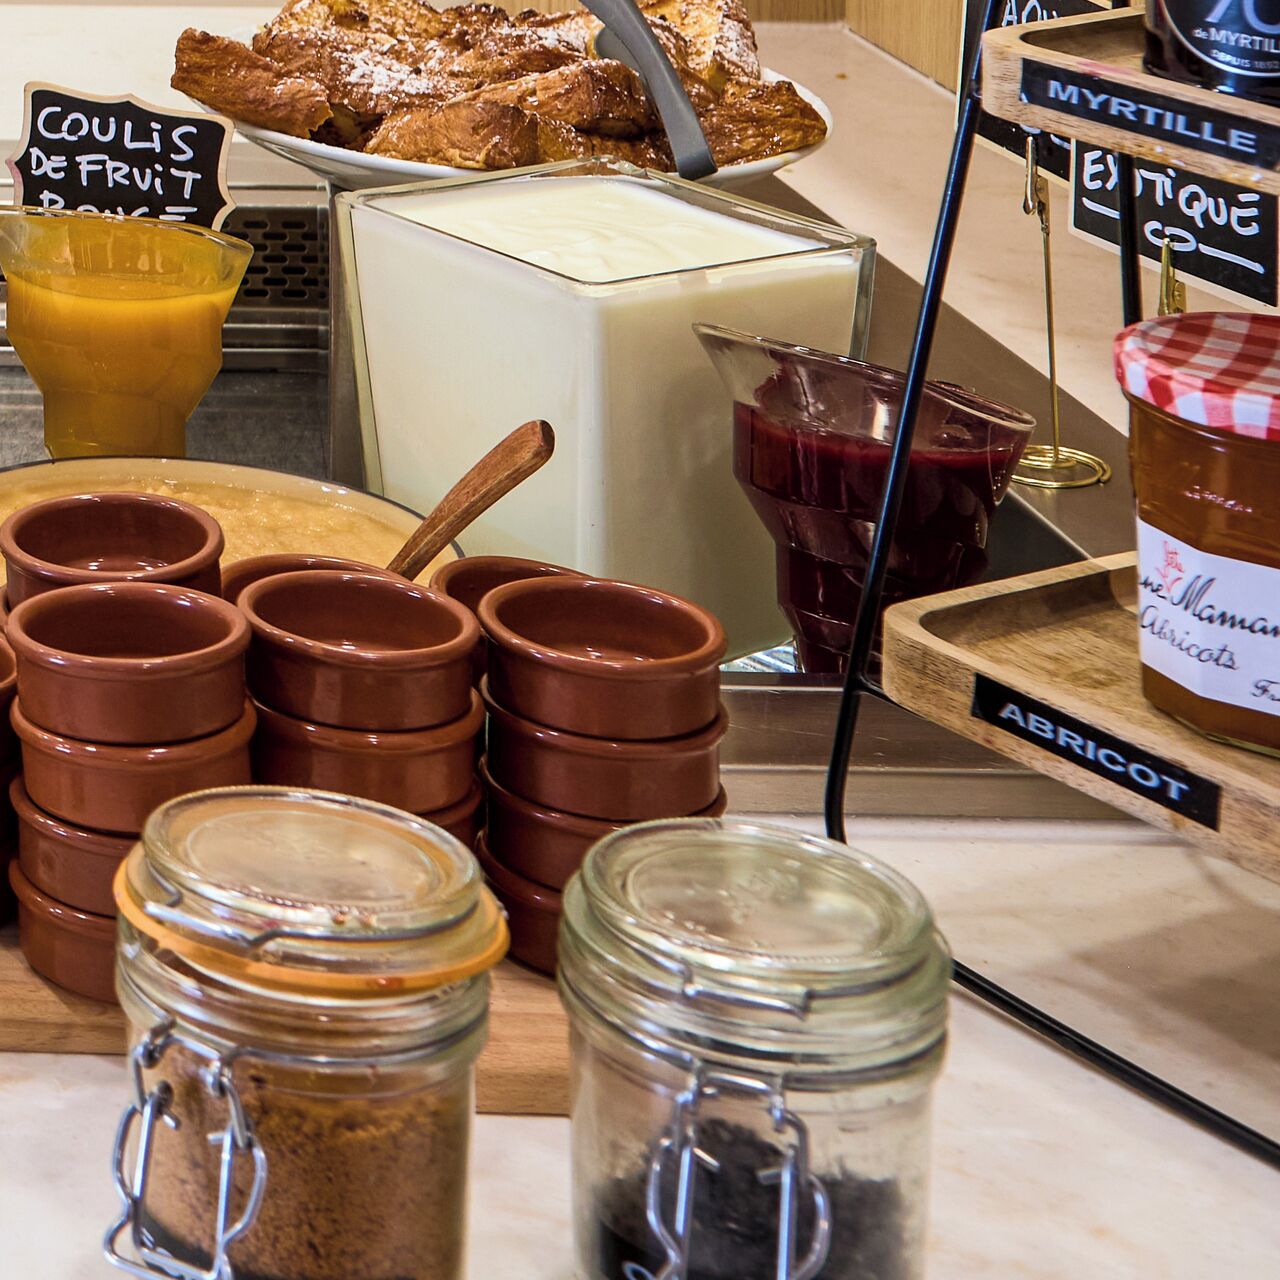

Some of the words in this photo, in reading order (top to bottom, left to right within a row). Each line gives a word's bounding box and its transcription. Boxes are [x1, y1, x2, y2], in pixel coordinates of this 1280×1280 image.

[1192, 27, 1209, 40] de
[1046, 78, 1258, 155] MYRTILLE
[29, 146, 68, 180] DE
[998, 702, 1191, 802] ABRICOT
